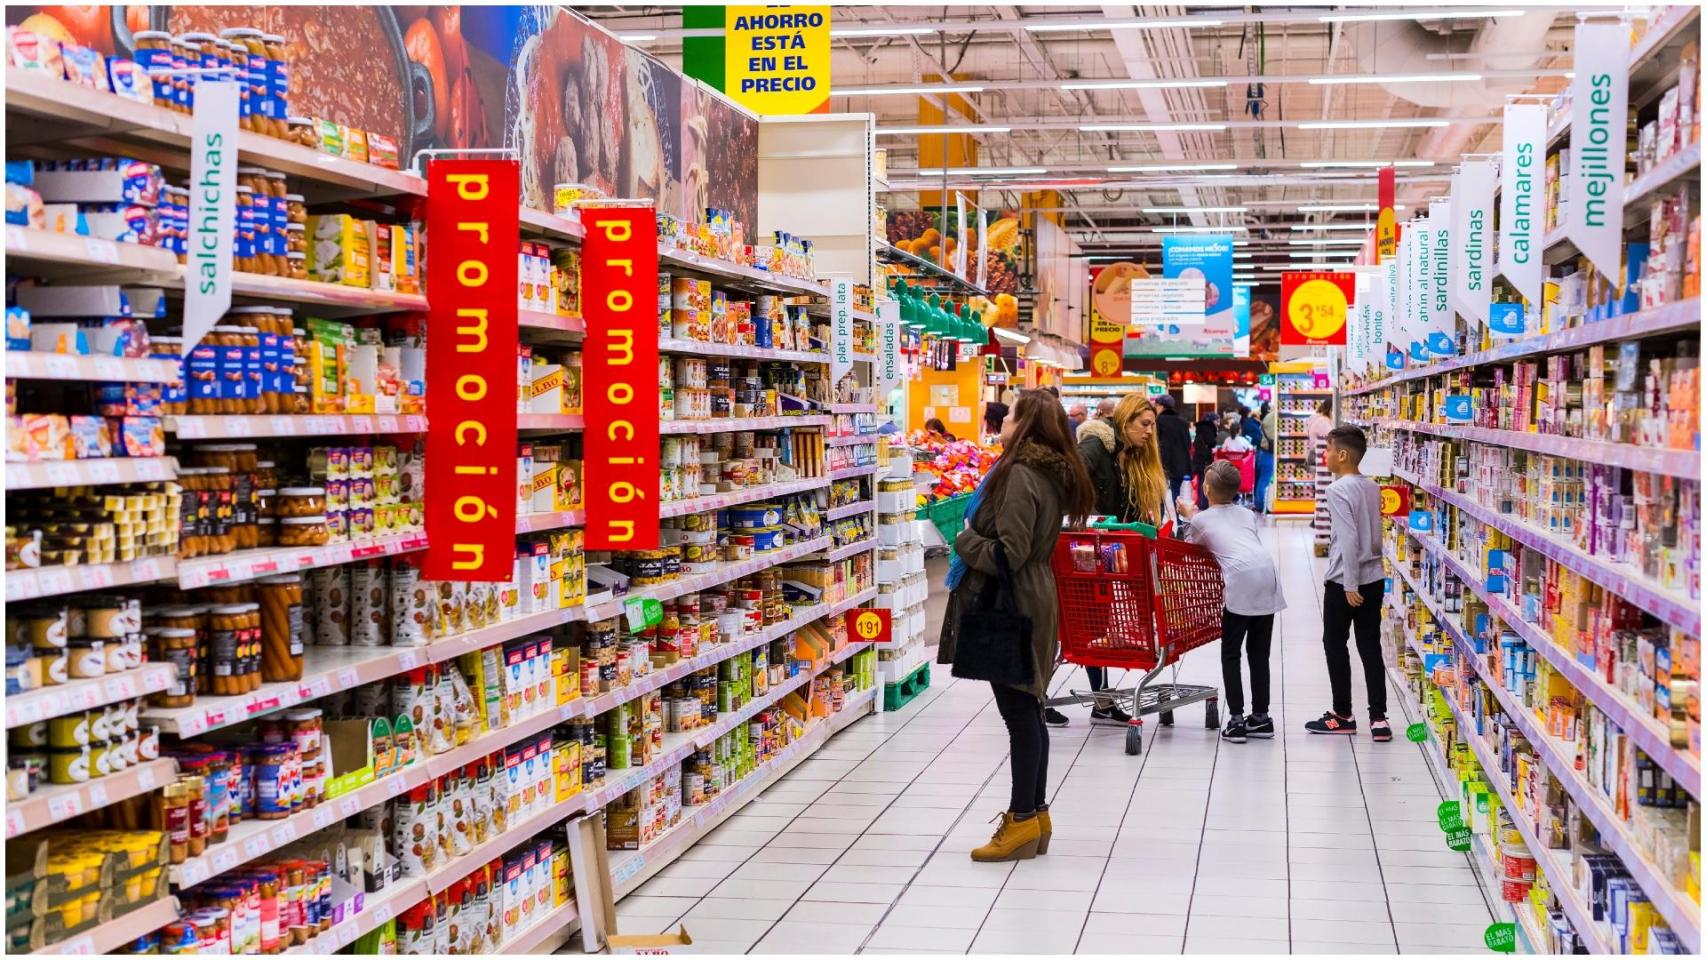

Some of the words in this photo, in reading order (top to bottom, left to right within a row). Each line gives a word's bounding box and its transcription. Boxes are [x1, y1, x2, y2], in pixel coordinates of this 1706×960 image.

[734, 13, 823, 30] AHORRO
[752, 31, 806, 50] ESTÁ
[749, 57, 776, 71] EN
[784, 56, 808, 70] EL
[742, 77, 816, 93] PRECIO
[1582, 73, 1614, 227] mejillones
[199, 133, 222, 294] salchichas
[1509, 142, 1533, 264] calamares
[1418, 230, 1428, 276] natural
[1466, 209, 1483, 291] sardinas
[1418, 279, 1428, 290] al
[1434, 229, 1449, 312] sardinillas
[836, 283, 846, 303] lata
[838, 307, 848, 335] prep.
[1373, 311, 1383, 344] bonito
[836, 342, 848, 363] plat.
[884, 323, 894, 379] ensaladas
[446, 174, 498, 570] promoción
[596, 220, 645, 542] promoción
